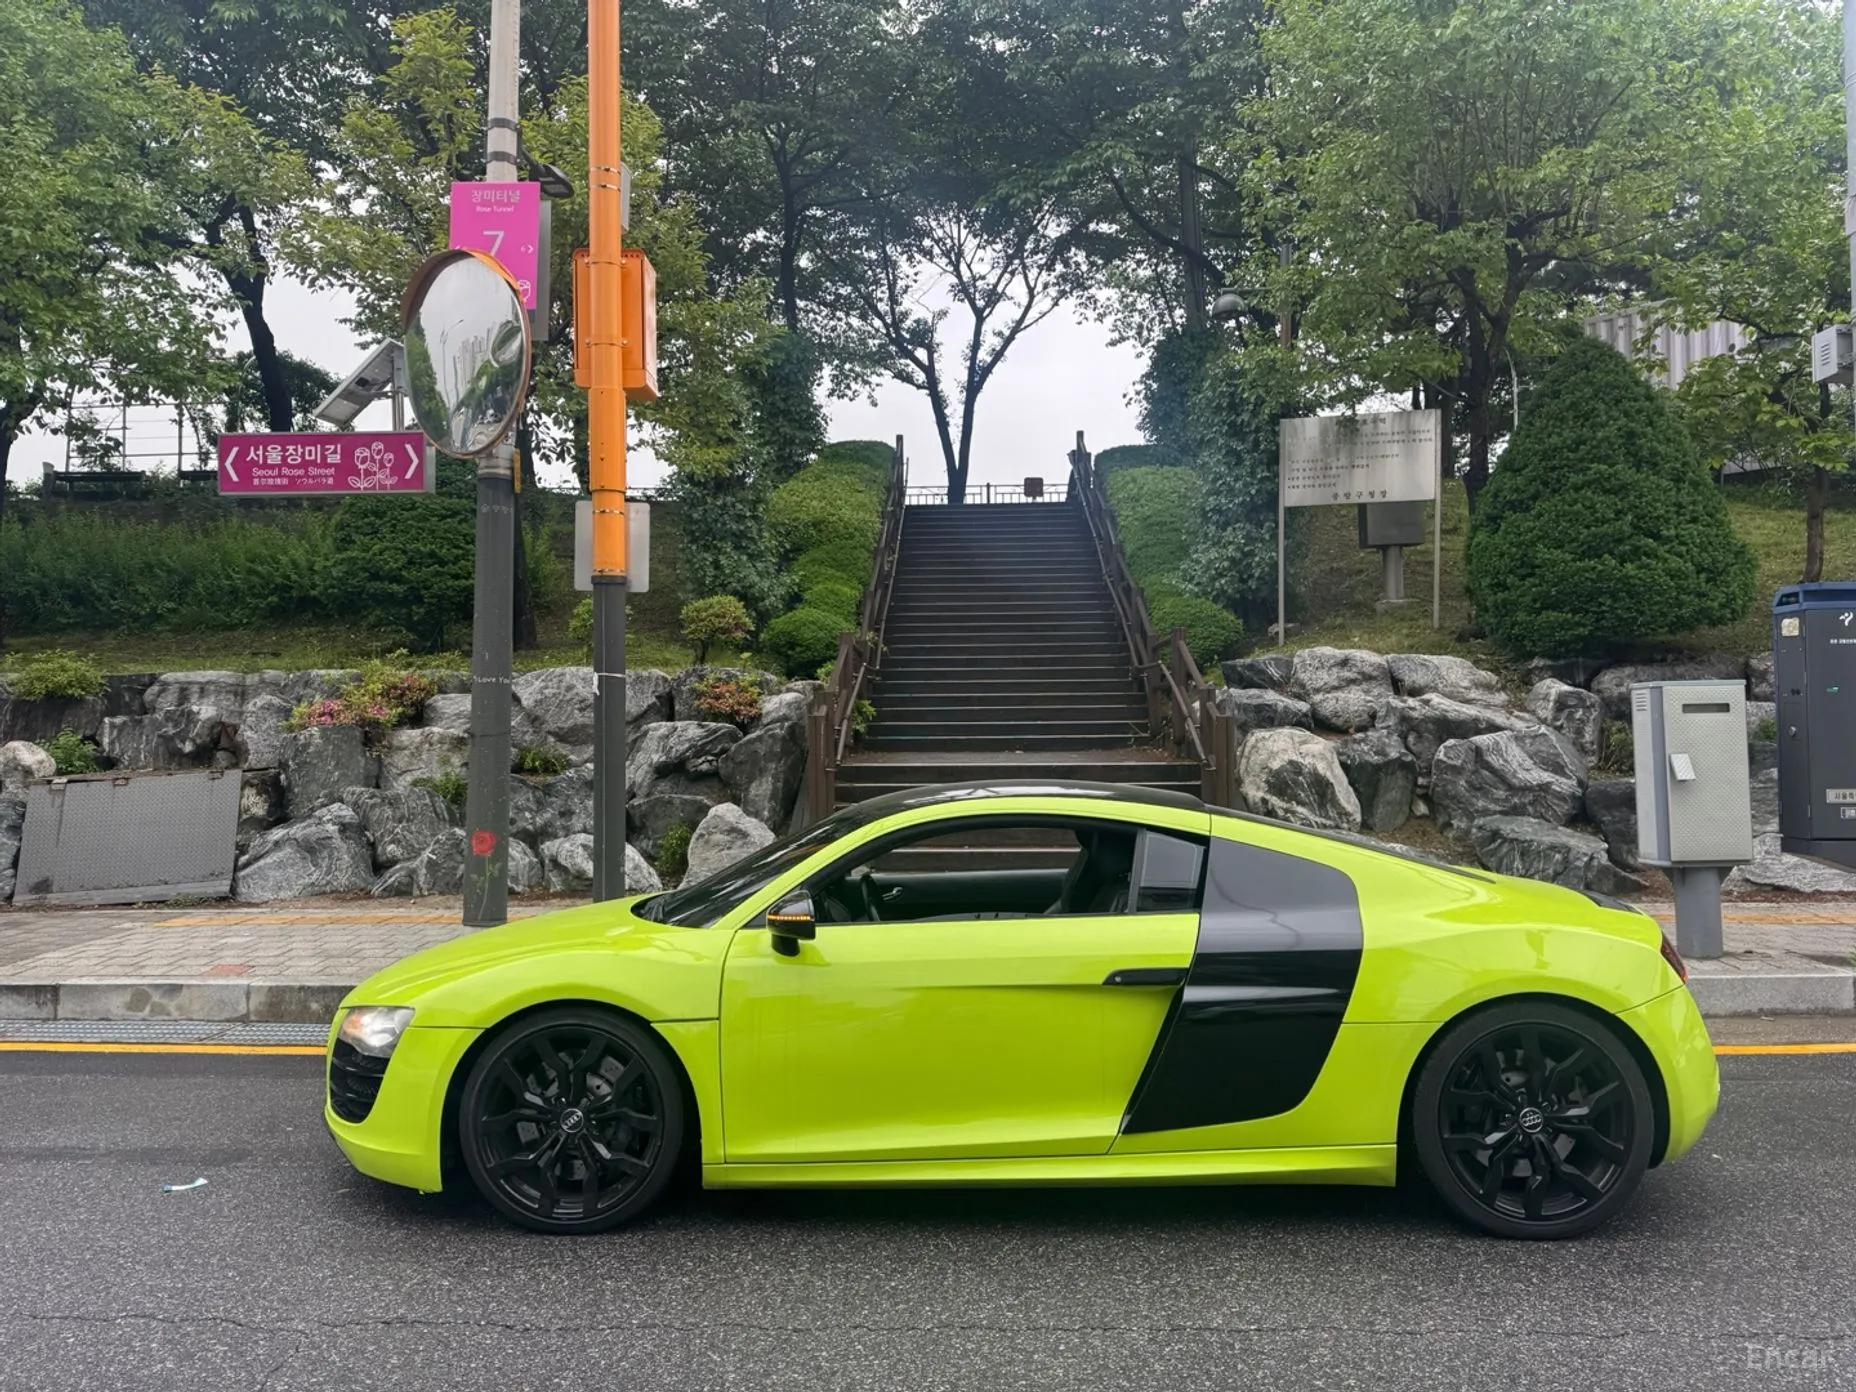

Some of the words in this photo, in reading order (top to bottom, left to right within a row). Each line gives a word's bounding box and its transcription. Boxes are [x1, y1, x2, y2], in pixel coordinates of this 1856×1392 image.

[471, 189, 521, 203] 장미터널
[483, 230, 504, 256] 7
[246, 443, 342, 464] 서울장미길
[252, 468, 279, 476] Seoul
[281, 467, 305, 476] Rose
[308, 466, 335, 476] Street
